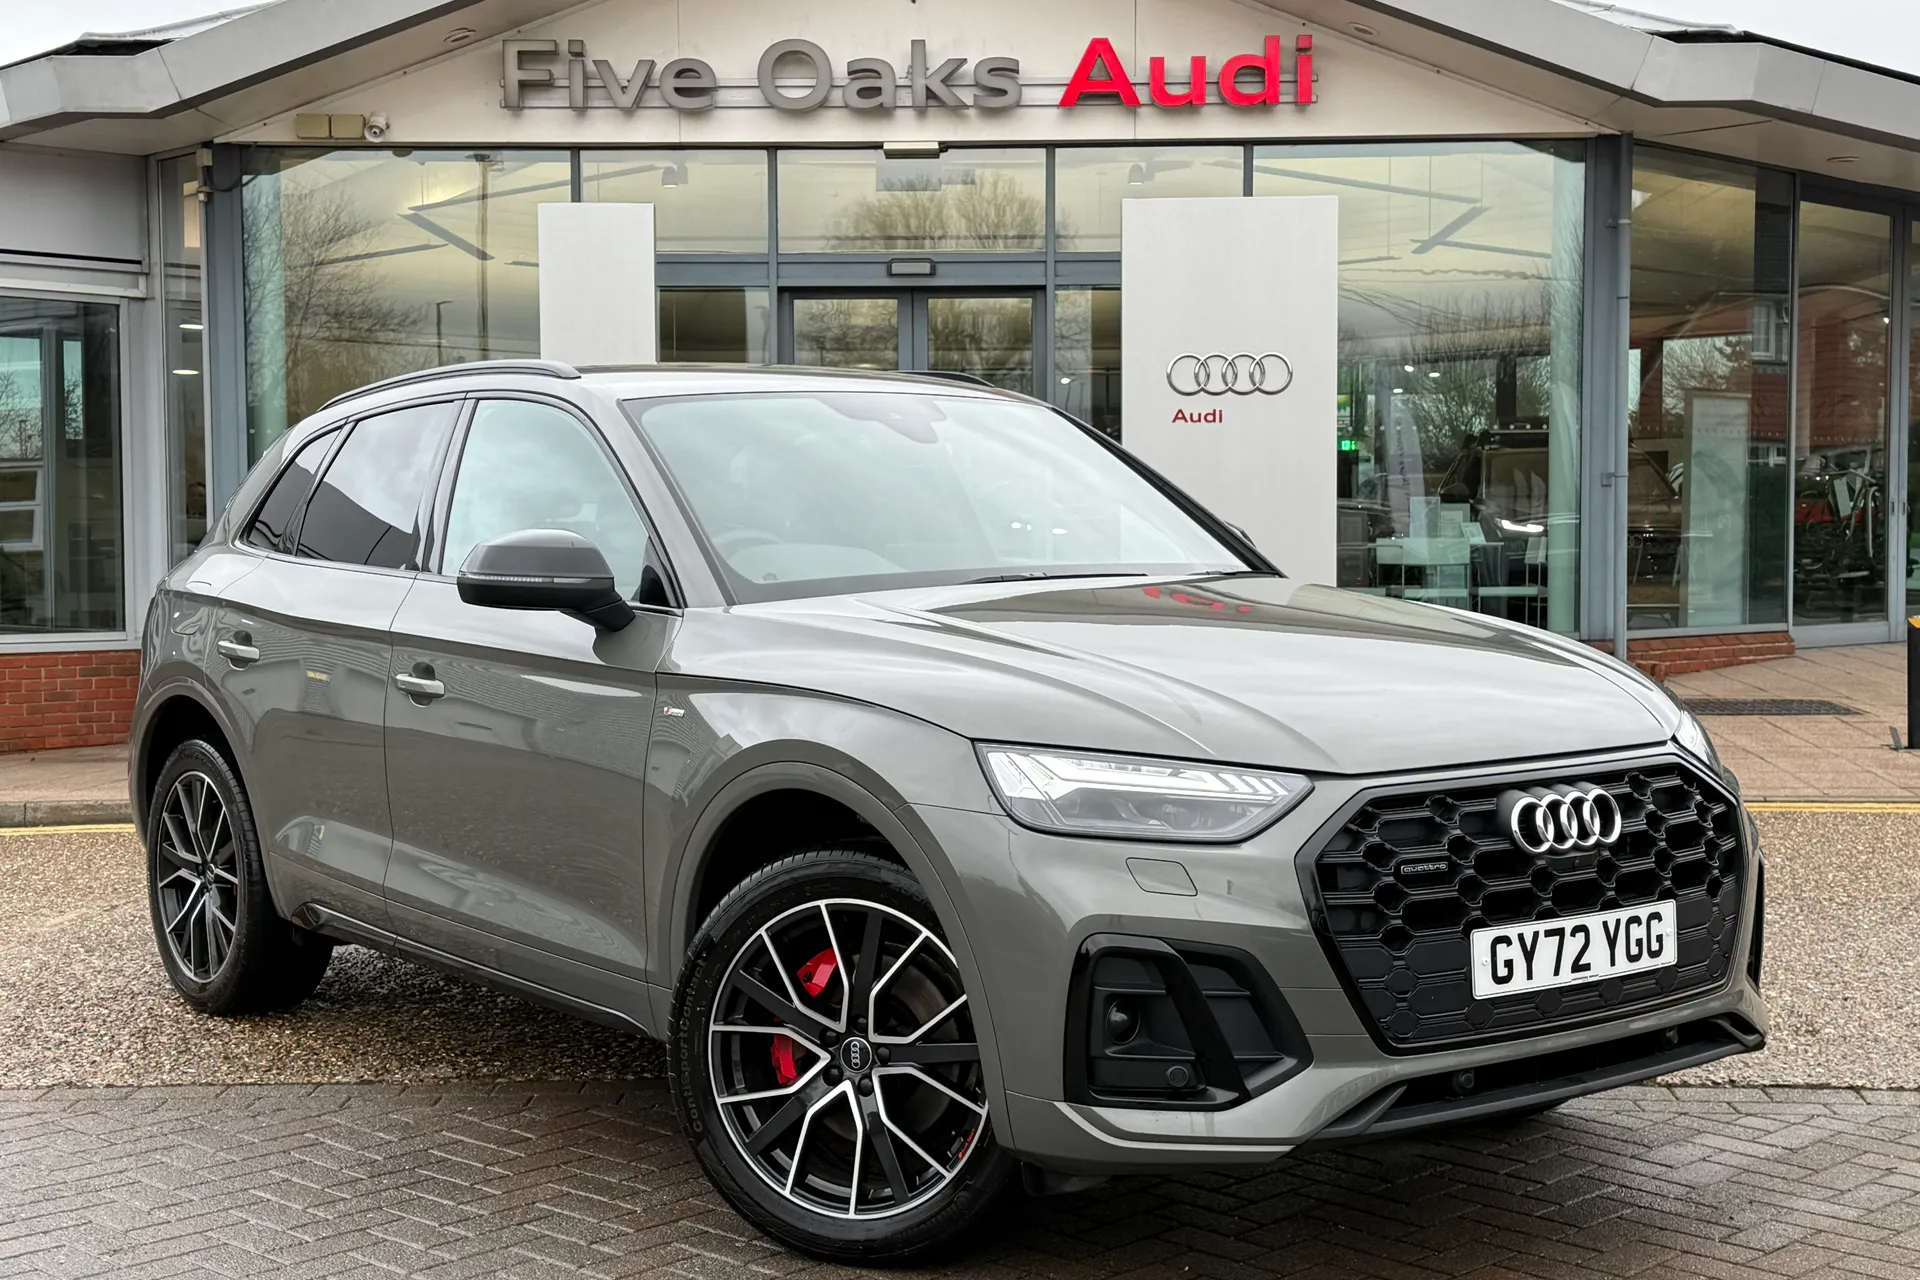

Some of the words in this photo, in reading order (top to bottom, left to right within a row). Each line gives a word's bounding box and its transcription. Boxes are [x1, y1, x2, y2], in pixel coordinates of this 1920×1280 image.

[502, 39, 718, 111] Five
[757, 38, 1022, 111] Oaks
[1058, 34, 1314, 108] Audi
[1171, 408, 1223, 424] Audi
[1403, 863, 1447, 873] quattro
[1490, 924, 1592, 986] GY72
[1602, 911, 1664, 968] YGG
